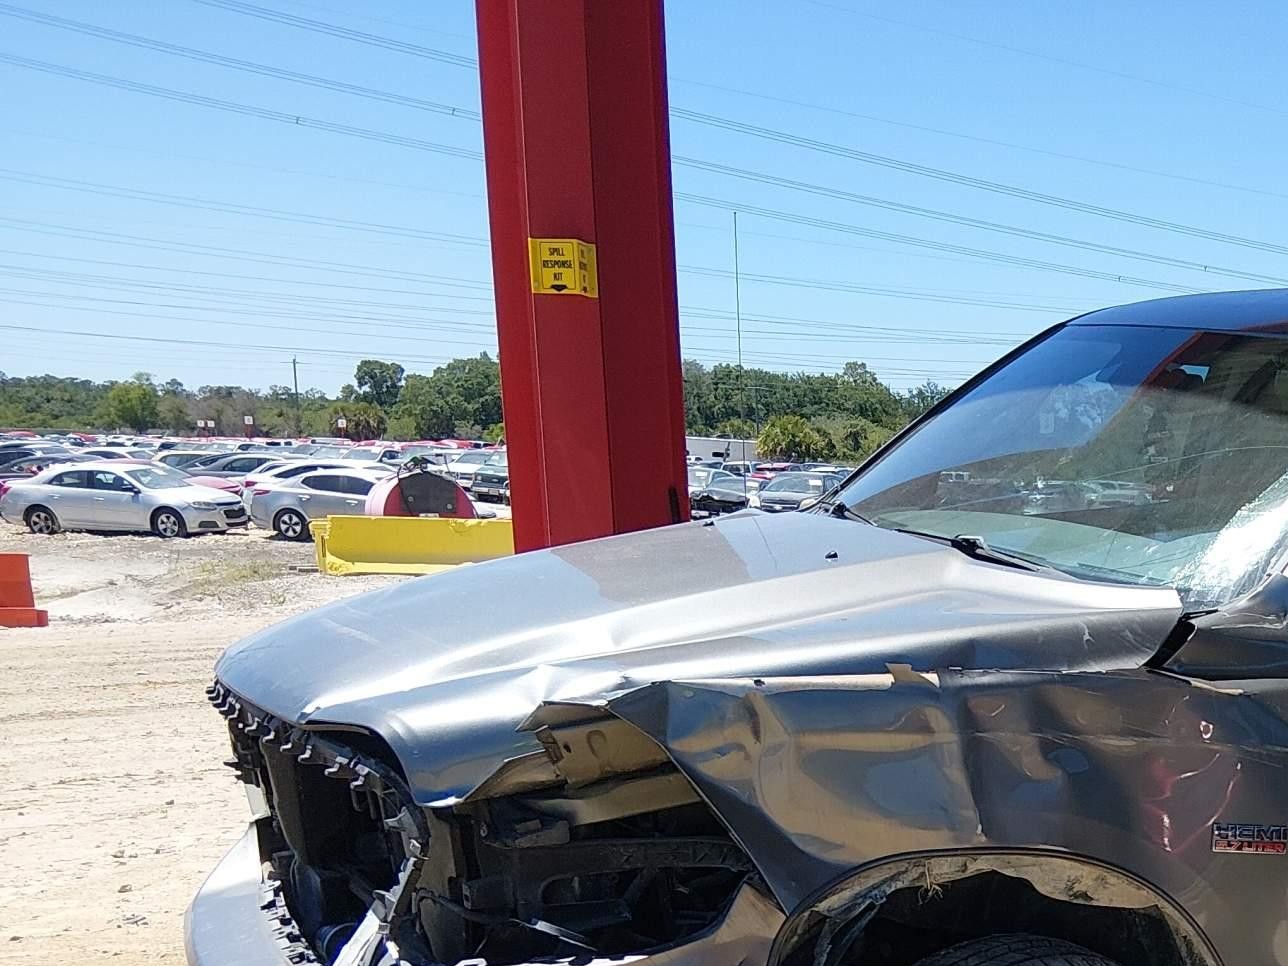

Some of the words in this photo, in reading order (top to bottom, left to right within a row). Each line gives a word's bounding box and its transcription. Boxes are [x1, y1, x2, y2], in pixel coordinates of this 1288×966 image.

[548, 248, 565, 256] SPILL
[543, 260, 573, 268] RESPONSE
[553, 272, 563, 281] KIT
[1213, 824, 1288, 841] HEMI
[1242, 841, 1284, 853] LITER
